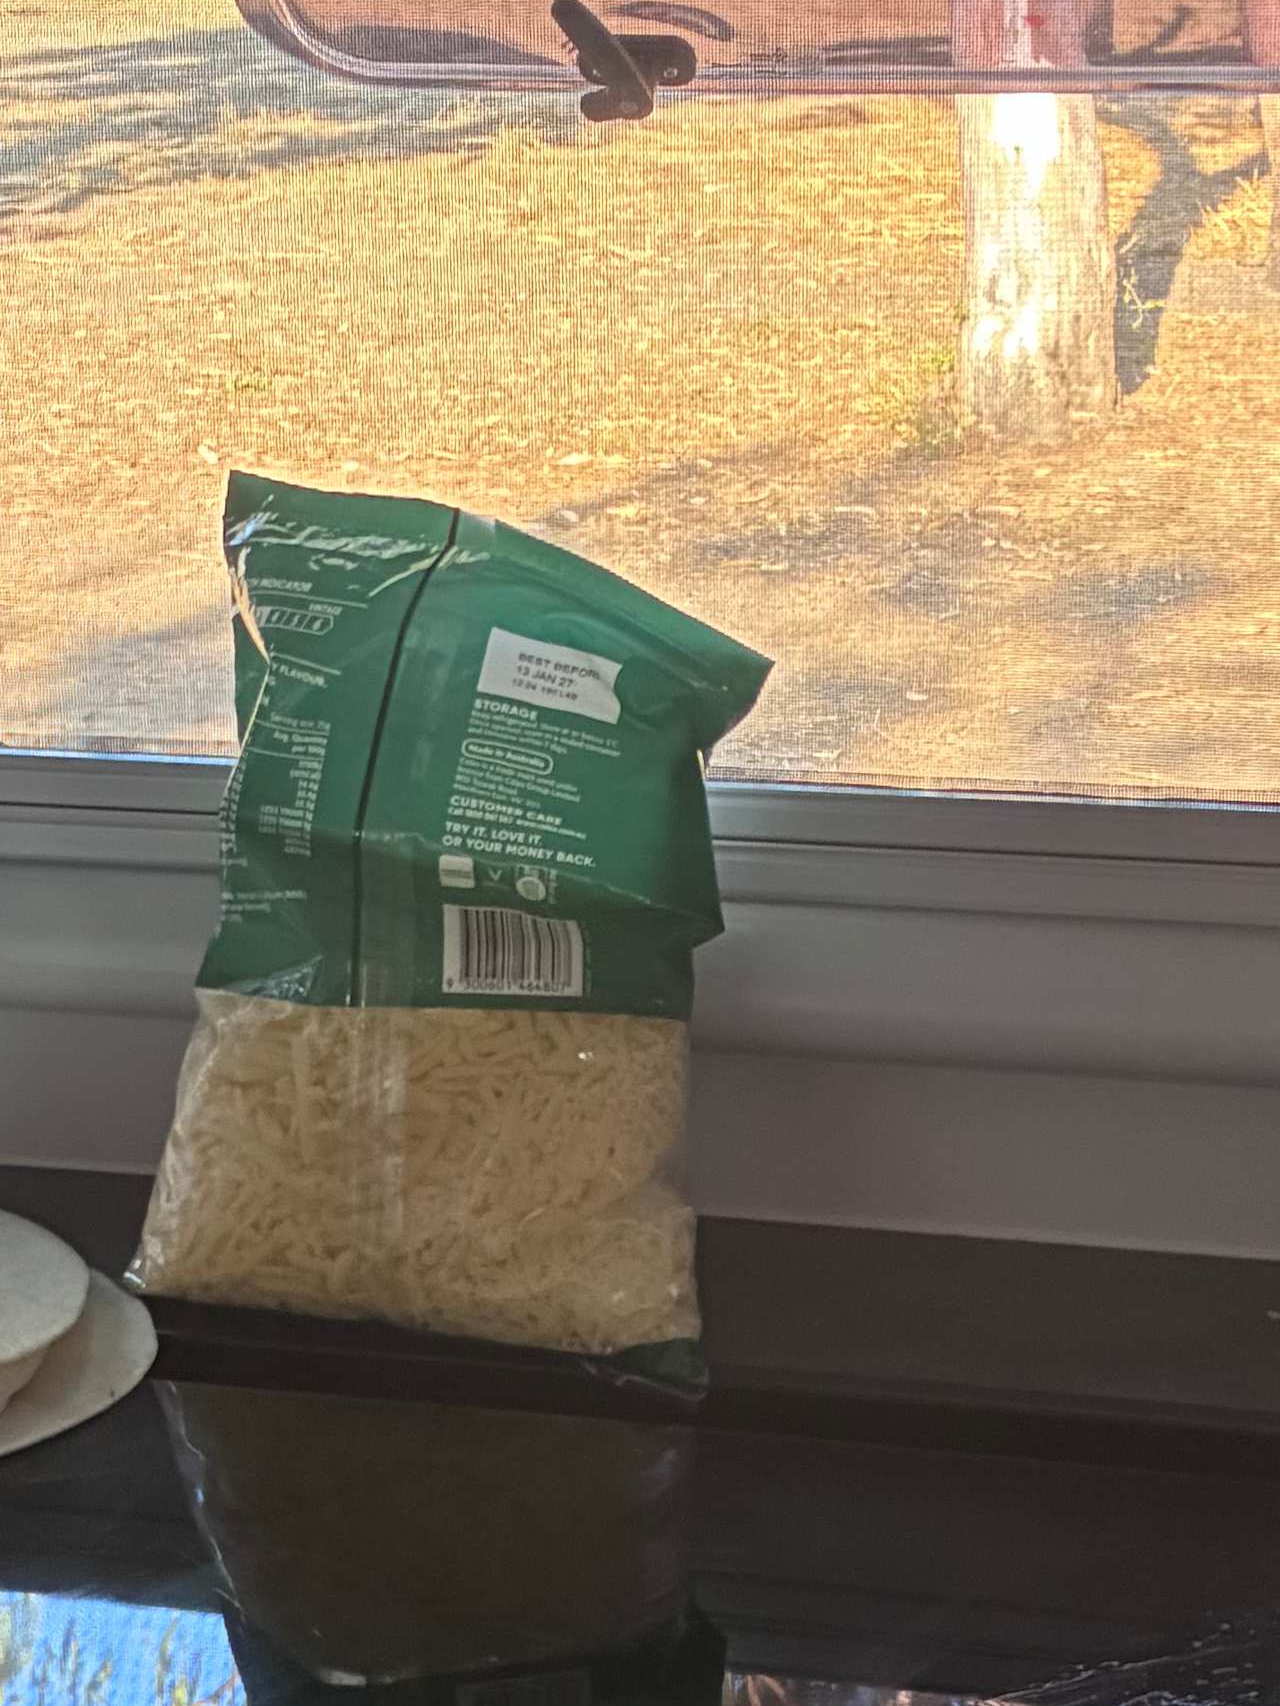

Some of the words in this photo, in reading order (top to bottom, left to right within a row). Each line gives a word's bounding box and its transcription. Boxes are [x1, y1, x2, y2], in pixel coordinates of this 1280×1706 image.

[518, 652, 551, 667] BEST
[533, 670, 556, 684] JAN
[473, 698, 538, 721] STORAGE
[450, 795, 523, 817] CUSTOMER
[526, 810, 563, 826] CARE
[445, 820, 470, 835] TRY
[473, 825, 488, 838] IT.
[491, 829, 526, 843] LOVE
[442, 834, 463, 847] OR
[466, 837, 503, 853] YOUR
[505, 844, 555, 860] MONEY
[556, 850, 597, 867] BACK.
